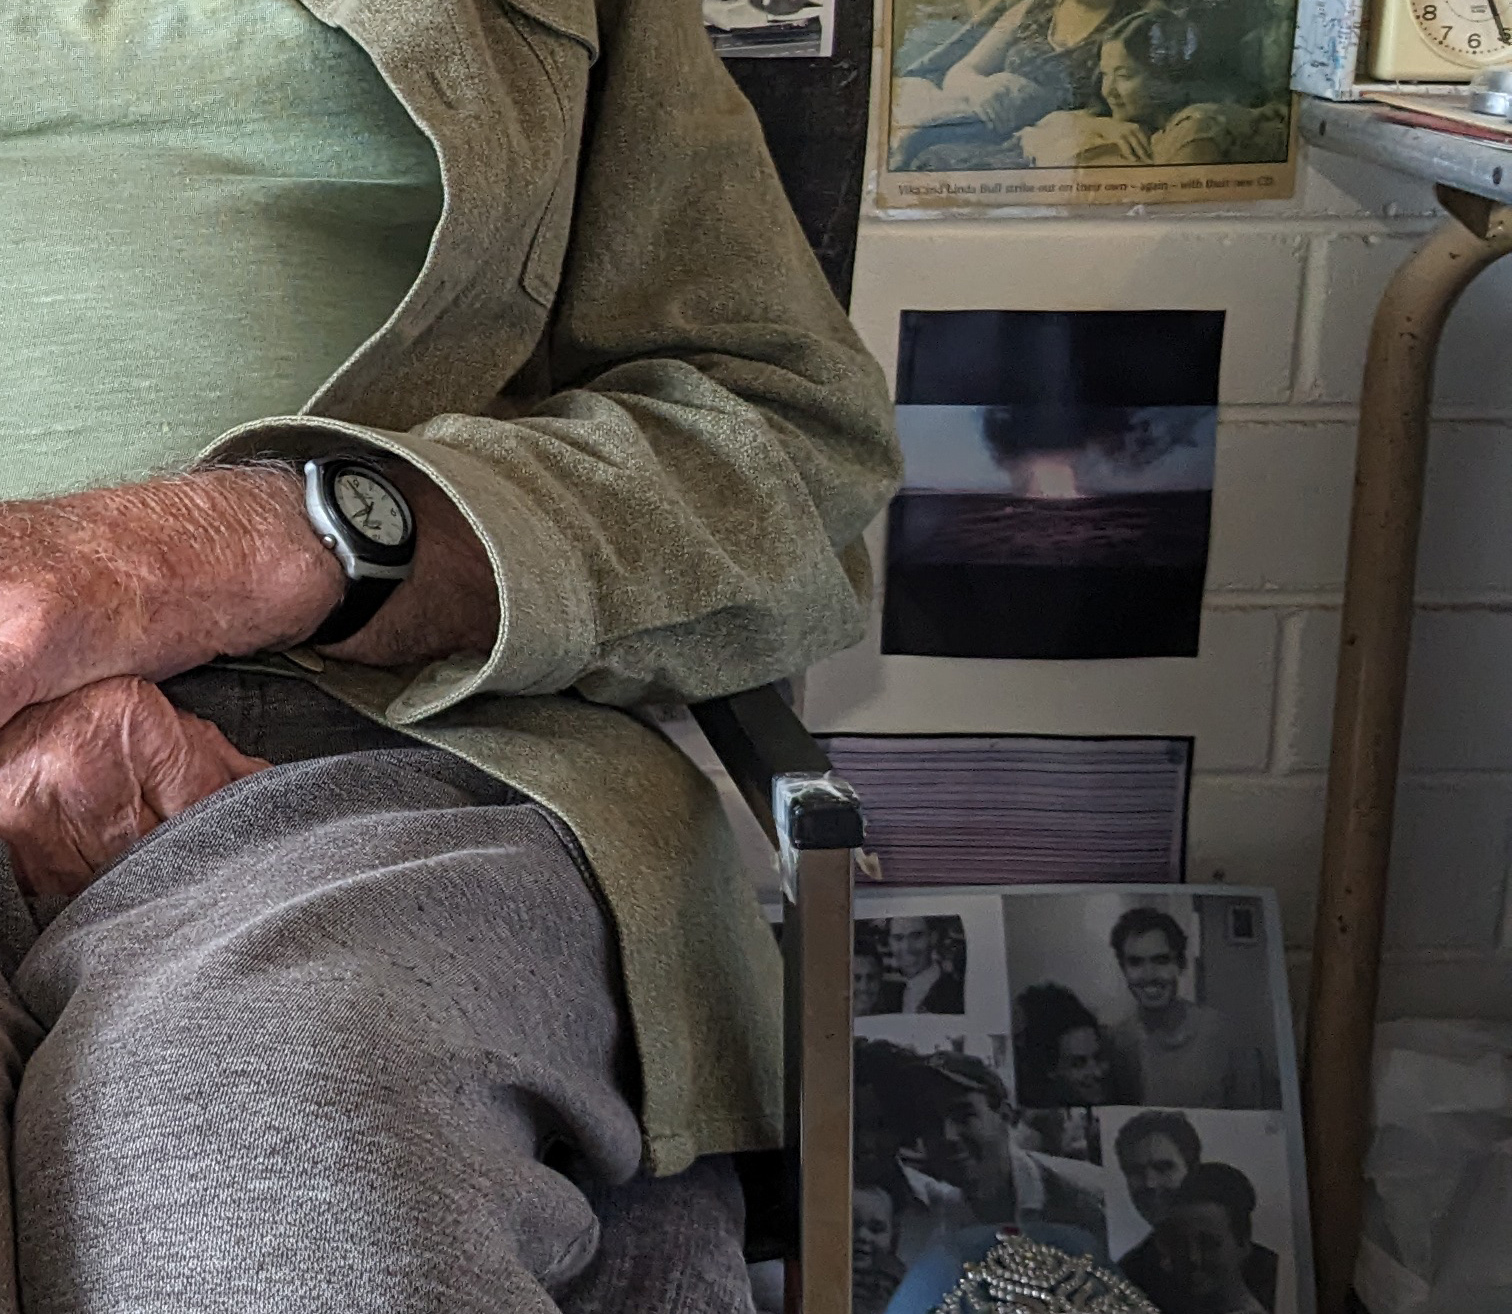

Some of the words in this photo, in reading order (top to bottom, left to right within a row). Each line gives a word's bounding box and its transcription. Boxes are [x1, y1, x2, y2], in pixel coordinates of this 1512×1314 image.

[1422, 4, 1437, 21] 8
[1440, 25, 1453, 42] 7
[1467, 33, 1482, 49] 6
[946, 183, 976, 194] Linda
[980, 182, 1002, 194] Bull
[1006, 182, 1035, 194] strike
[1038, 184, 1055, 193] out
[1059, 184, 1072, 193] on
[1104, 183, 1127, 192] own
[1140, 181, 1168, 192] again
[1180, 177, 1203, 189] with
